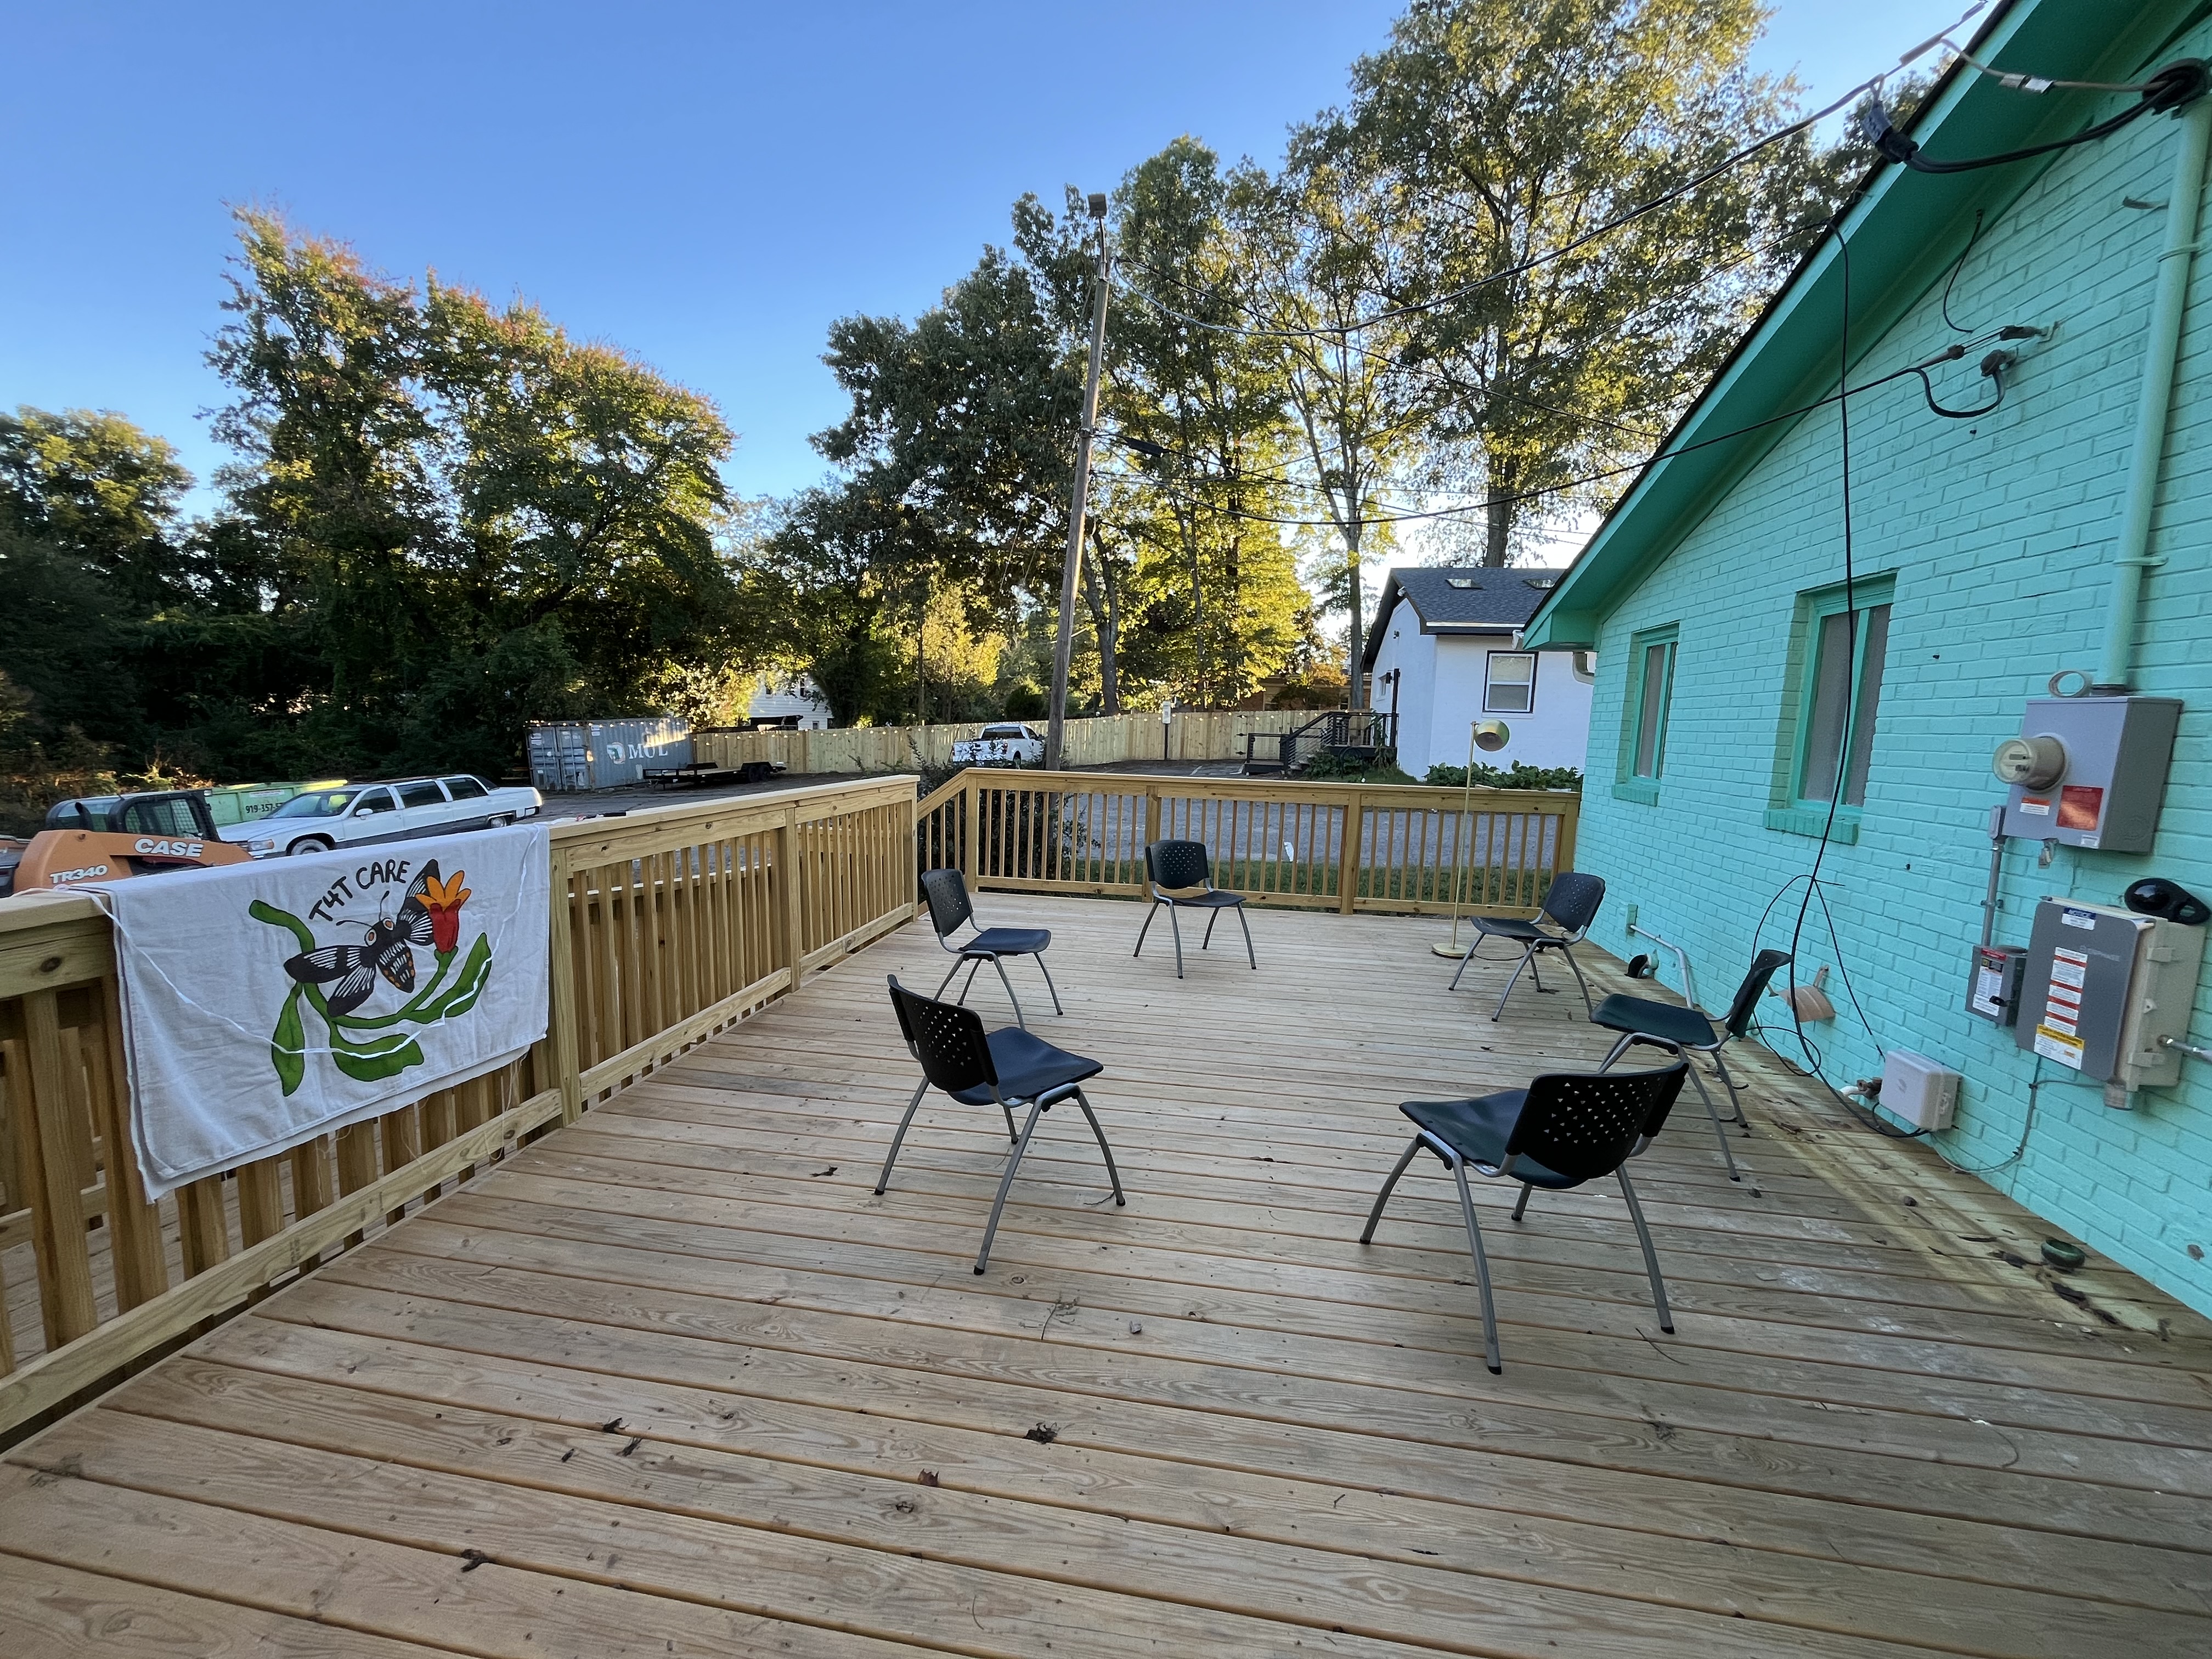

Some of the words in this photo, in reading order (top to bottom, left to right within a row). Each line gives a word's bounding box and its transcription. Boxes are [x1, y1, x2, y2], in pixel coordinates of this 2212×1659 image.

[134, 838, 204, 857] CASE
[50, 865, 109, 884] TR340
[308, 876, 353, 922] T4T
[356, 859, 411, 890] CARE
